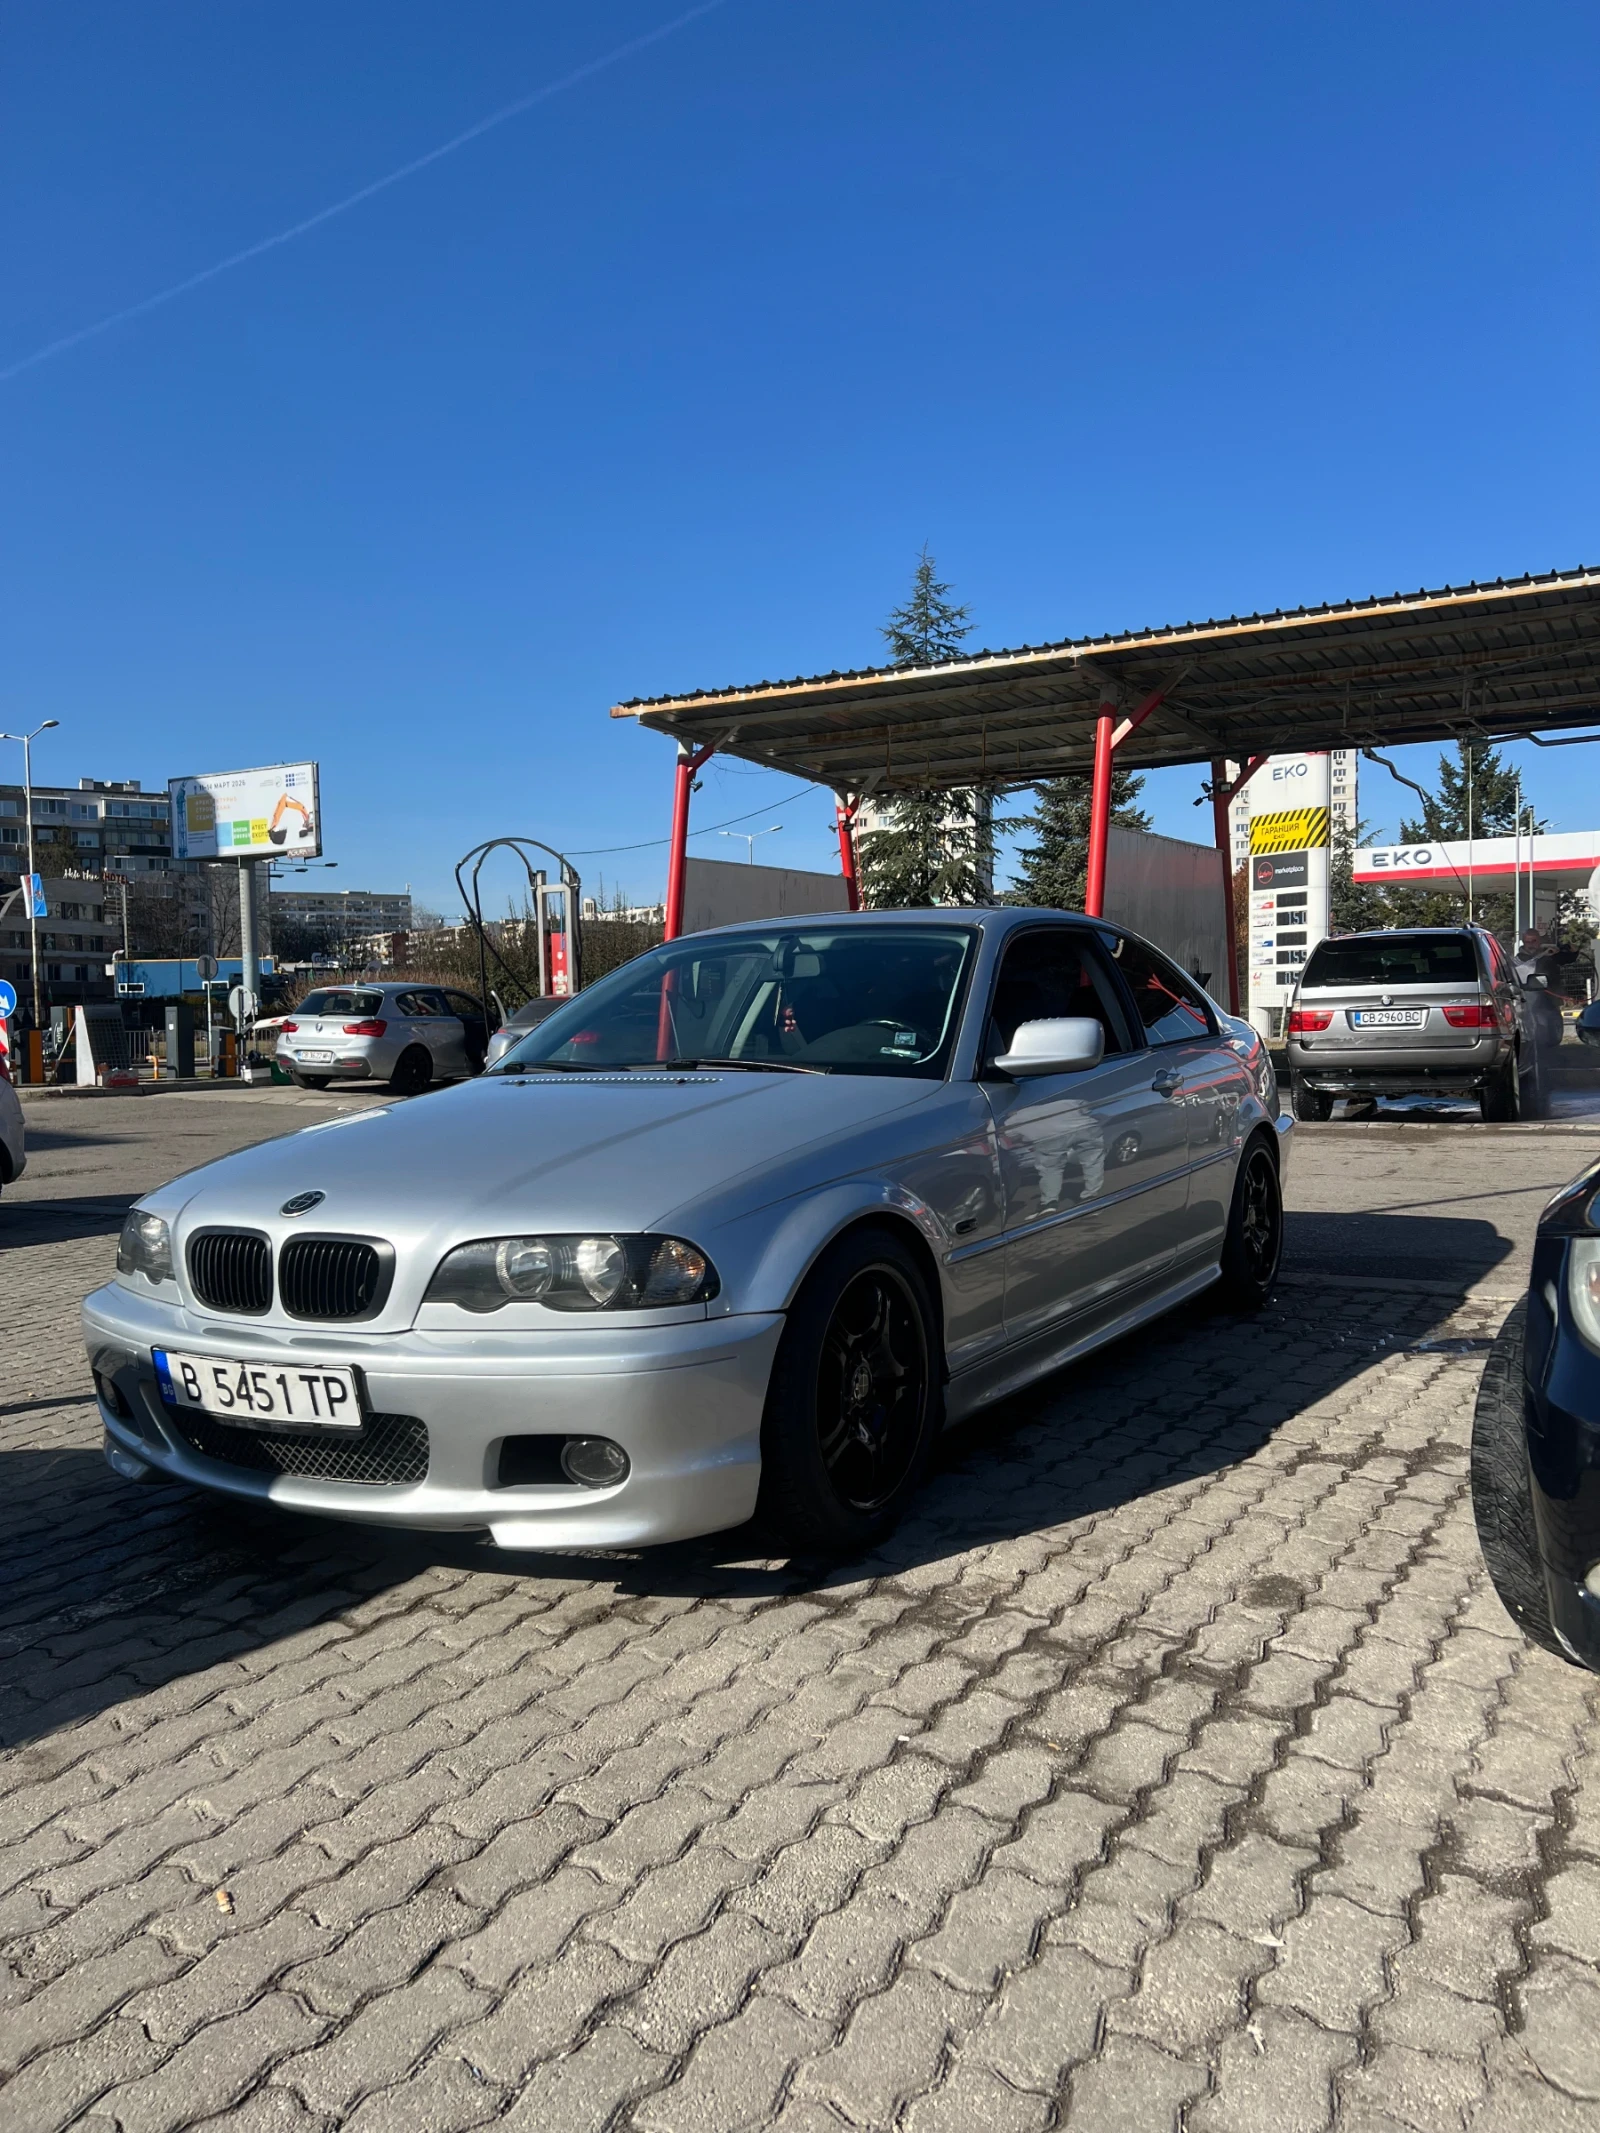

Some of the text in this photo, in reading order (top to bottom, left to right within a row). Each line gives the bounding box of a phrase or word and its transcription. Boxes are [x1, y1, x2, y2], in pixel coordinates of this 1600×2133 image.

[1272, 763, 1308, 781] EKO
[214, 781, 230, 789] МАРТ
[232, 779, 246, 788] 2026
[1261, 823, 1300, 836] ГАРАНЦИЯ
[1372, 850, 1432, 867] EKO
[1362, 1011, 1420, 1023] CB 2960 BC
[161, 1382, 175, 1396] BG
[180, 1361, 348, 1417] B 5451 TP
